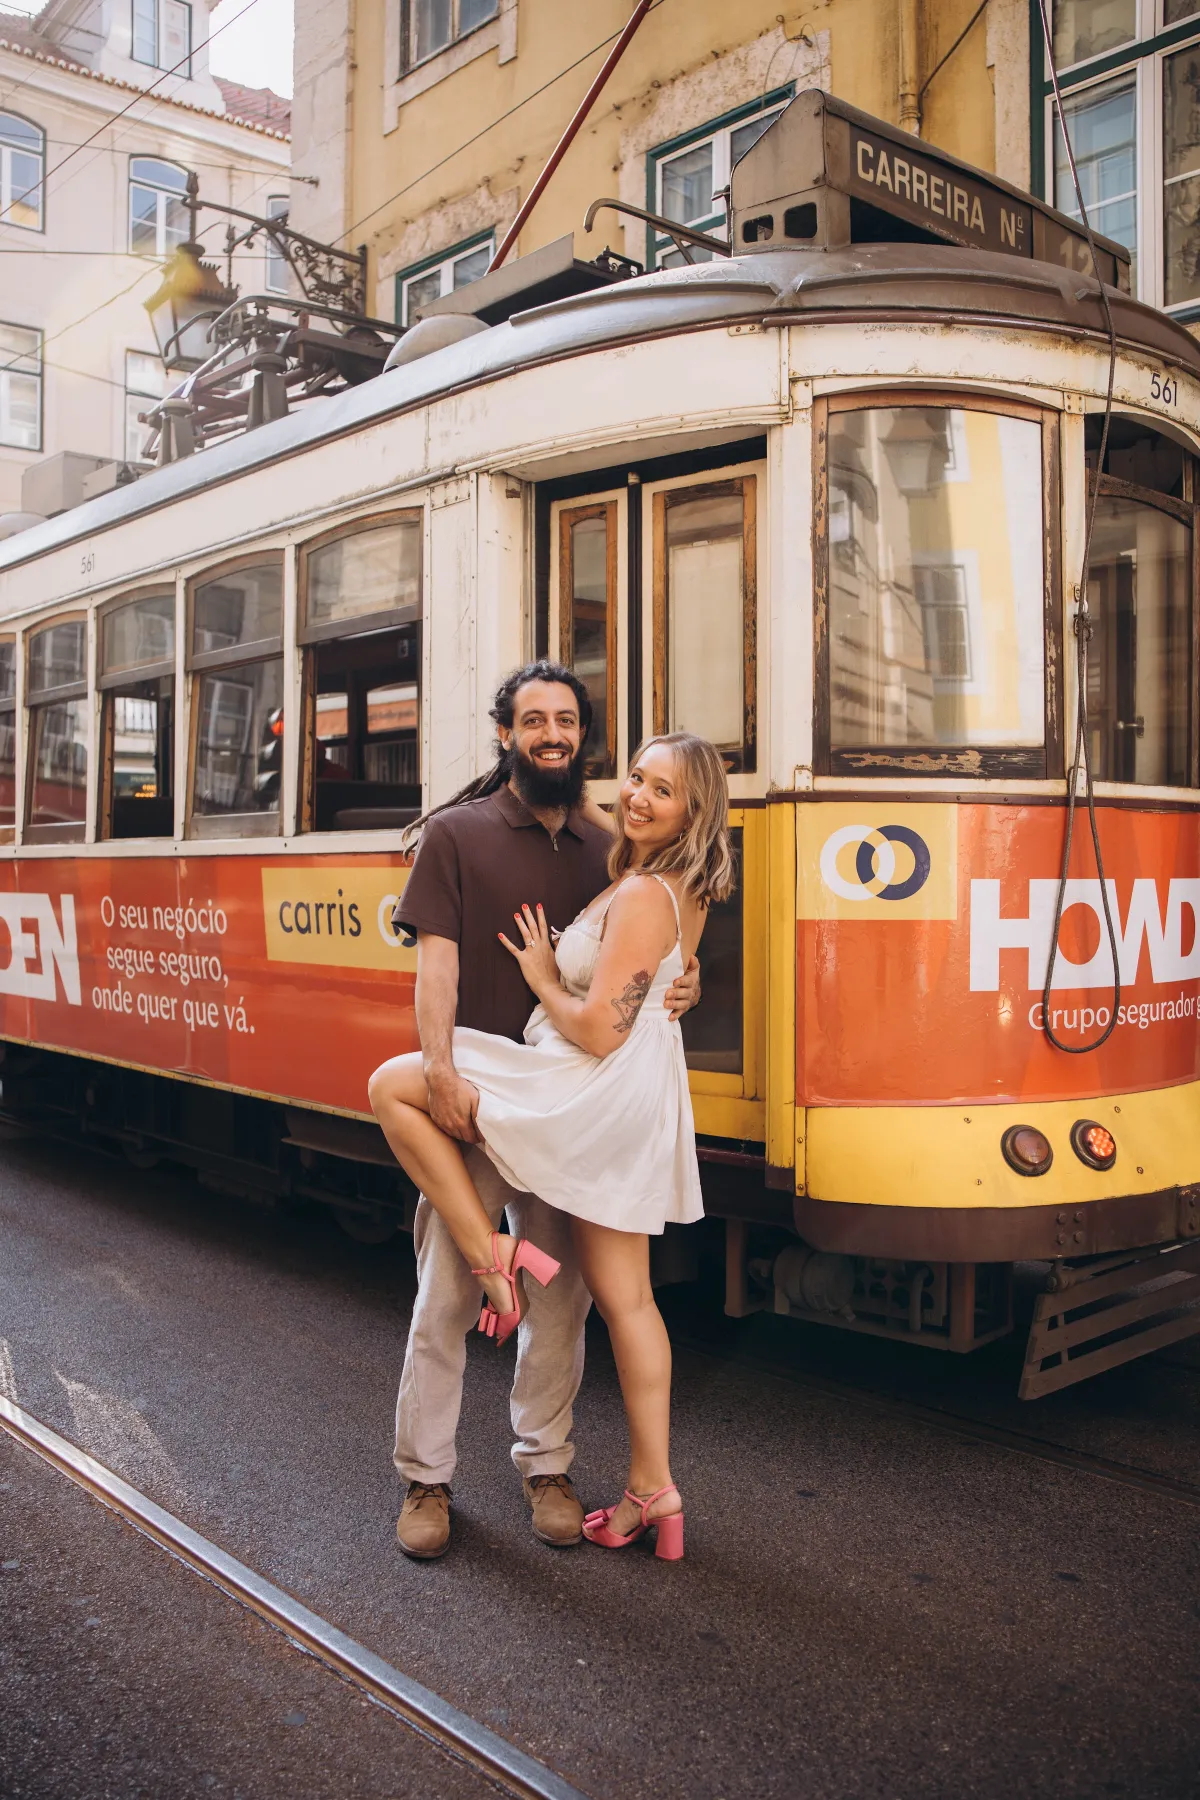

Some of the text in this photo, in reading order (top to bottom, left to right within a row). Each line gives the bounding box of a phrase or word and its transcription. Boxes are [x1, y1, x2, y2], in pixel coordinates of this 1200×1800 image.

[856, 140, 985, 234] CARREIRA
[1150, 373, 1178, 407] 561
[81, 553, 95, 574] 561
[100, 895, 228, 940] O seu negócio
[279, 888, 362, 938] carris
[969, 878, 1200, 992] HOWD
[106, 946, 229, 988] segue seguro,
[92, 980, 256, 1035] onde quer que vá.
[1028, 1002, 1110, 1034] Grupo
[1117, 991, 1195, 1029] segurador
